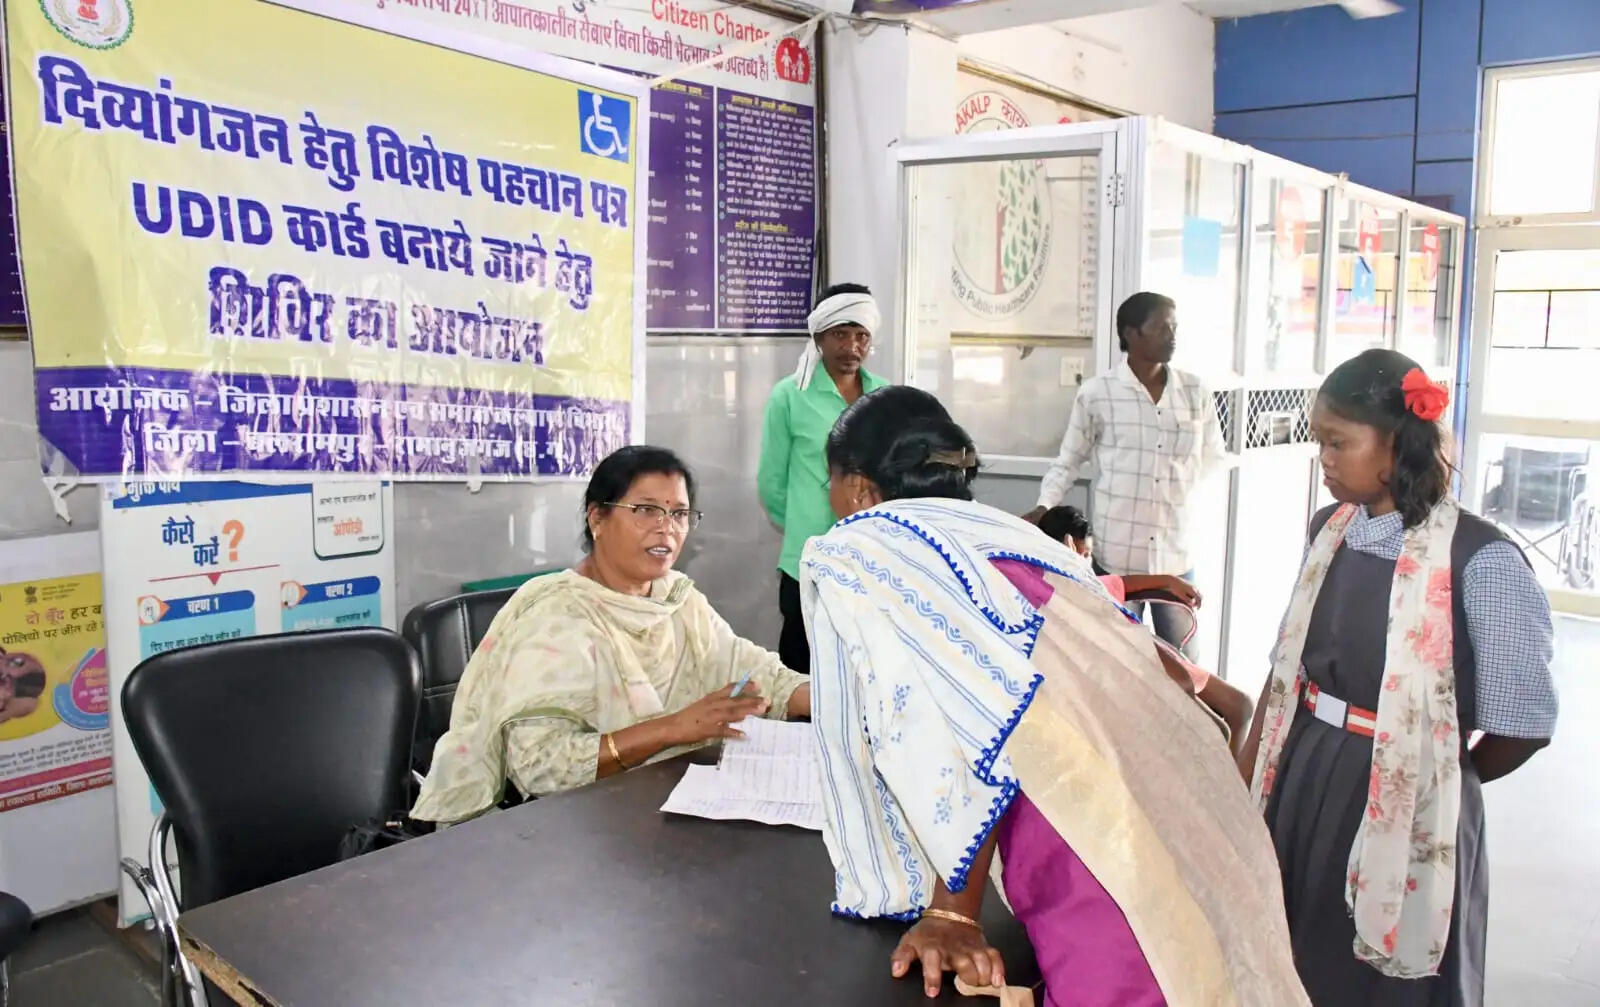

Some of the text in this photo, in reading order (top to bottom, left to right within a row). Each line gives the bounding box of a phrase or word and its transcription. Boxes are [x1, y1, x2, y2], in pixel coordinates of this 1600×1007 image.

[651, 0, 709, 33] Citizen
[955, 95, 992, 135] AKALP
[38, 56, 628, 228] दिव्यांगजन हेतु विशेष पहचान पत्र
[132, 182, 274, 246] UDID
[281, 202, 371, 259] कार्ड
[375, 219, 475, 277] बनाये
[481, 233, 548, 288] जाने
[554, 239, 593, 310] हेतु
[208, 266, 544, 365] शिविर का आयोजन
[50, 379, 189, 411] आयोजक
[219, 386, 293, 415] जिला
[143, 422, 217, 452] जिला
[161, 514, 195, 546] कैसे
[193, 535, 219, 567] करें
[347, 582, 354, 595] 2
[70, 605, 89, 620] हर
[187, 598, 210, 614] चरण
[2, 628, 40, 646] पोलियो
[43, 629, 58, 640] पर
